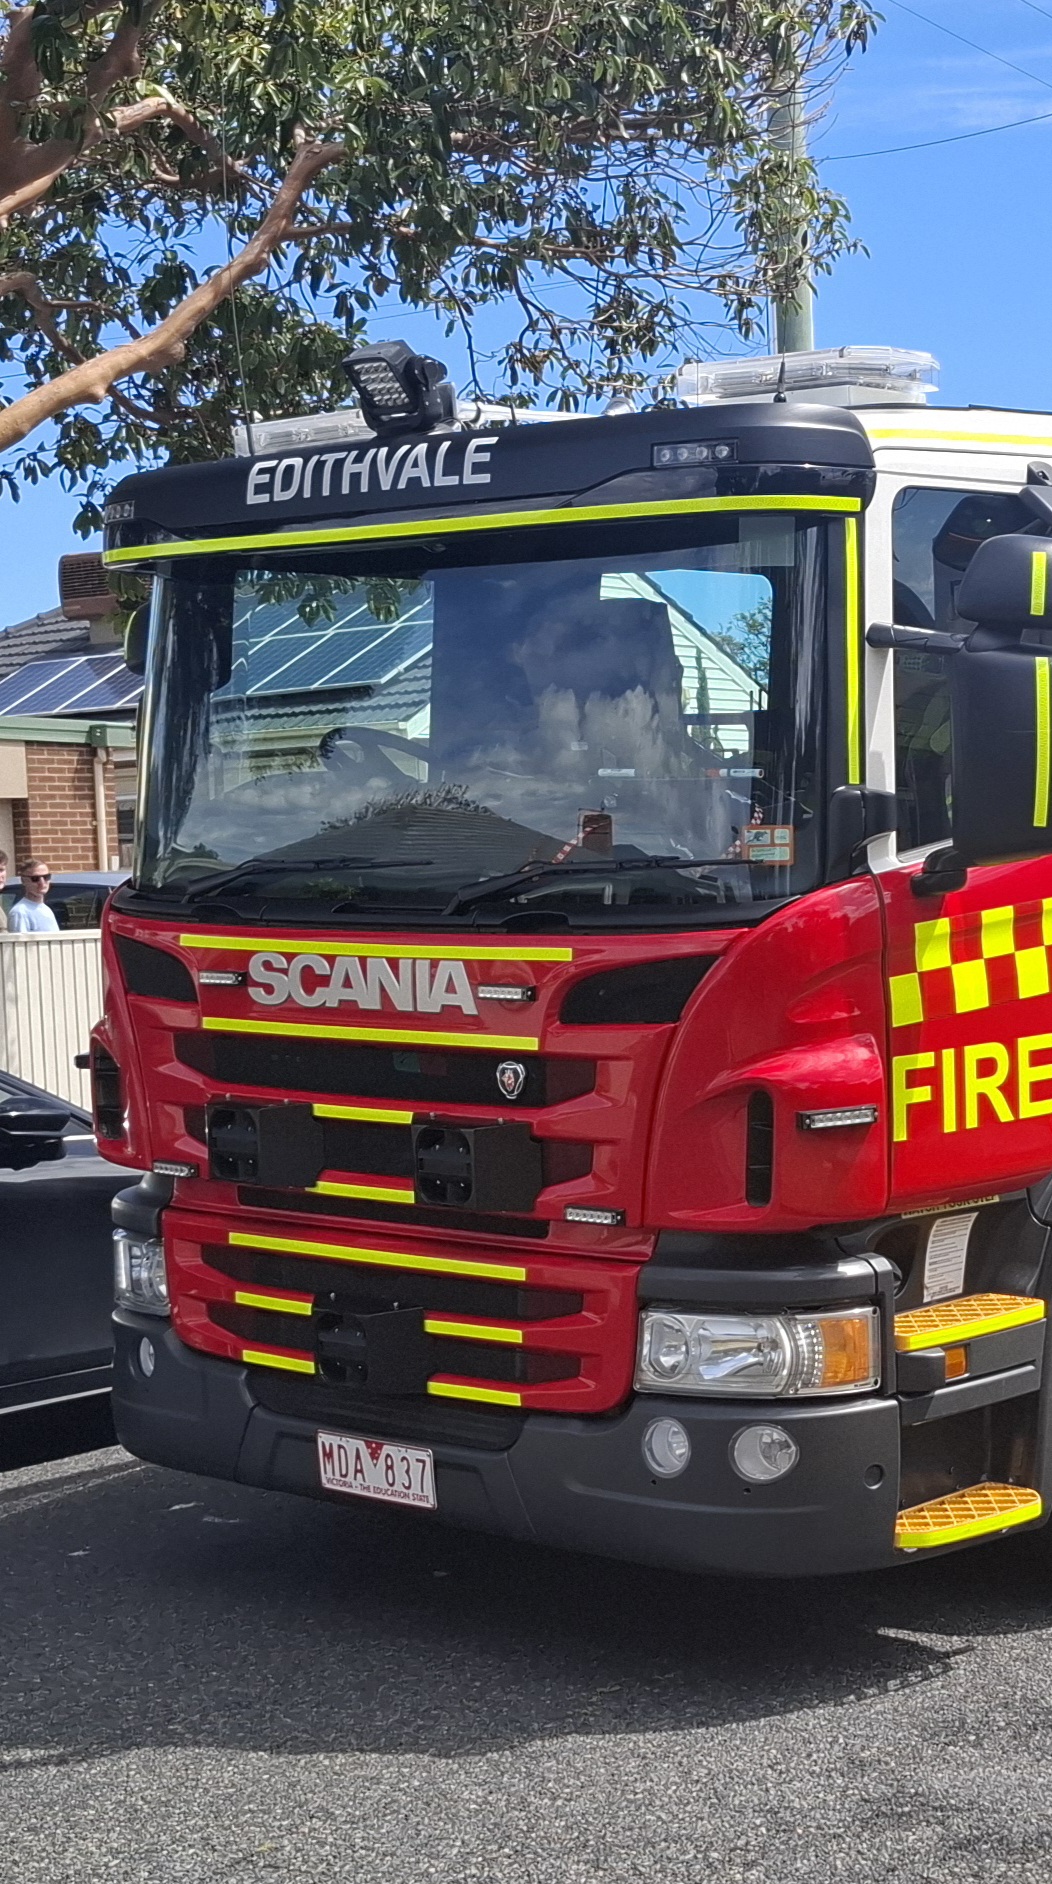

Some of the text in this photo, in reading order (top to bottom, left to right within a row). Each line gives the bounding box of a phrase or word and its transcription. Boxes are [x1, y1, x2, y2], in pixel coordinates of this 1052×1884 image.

[247, 436, 499, 505] EDITHVALE
[247, 952, 479, 1016] SCANIA
[321, 1440, 427, 1494] MDA 837
[325, 1476, 354, 1489] VICTORIA
[359, 1483, 371, 1493] THE
[373, 1486, 411, 1501] EDUCATION
